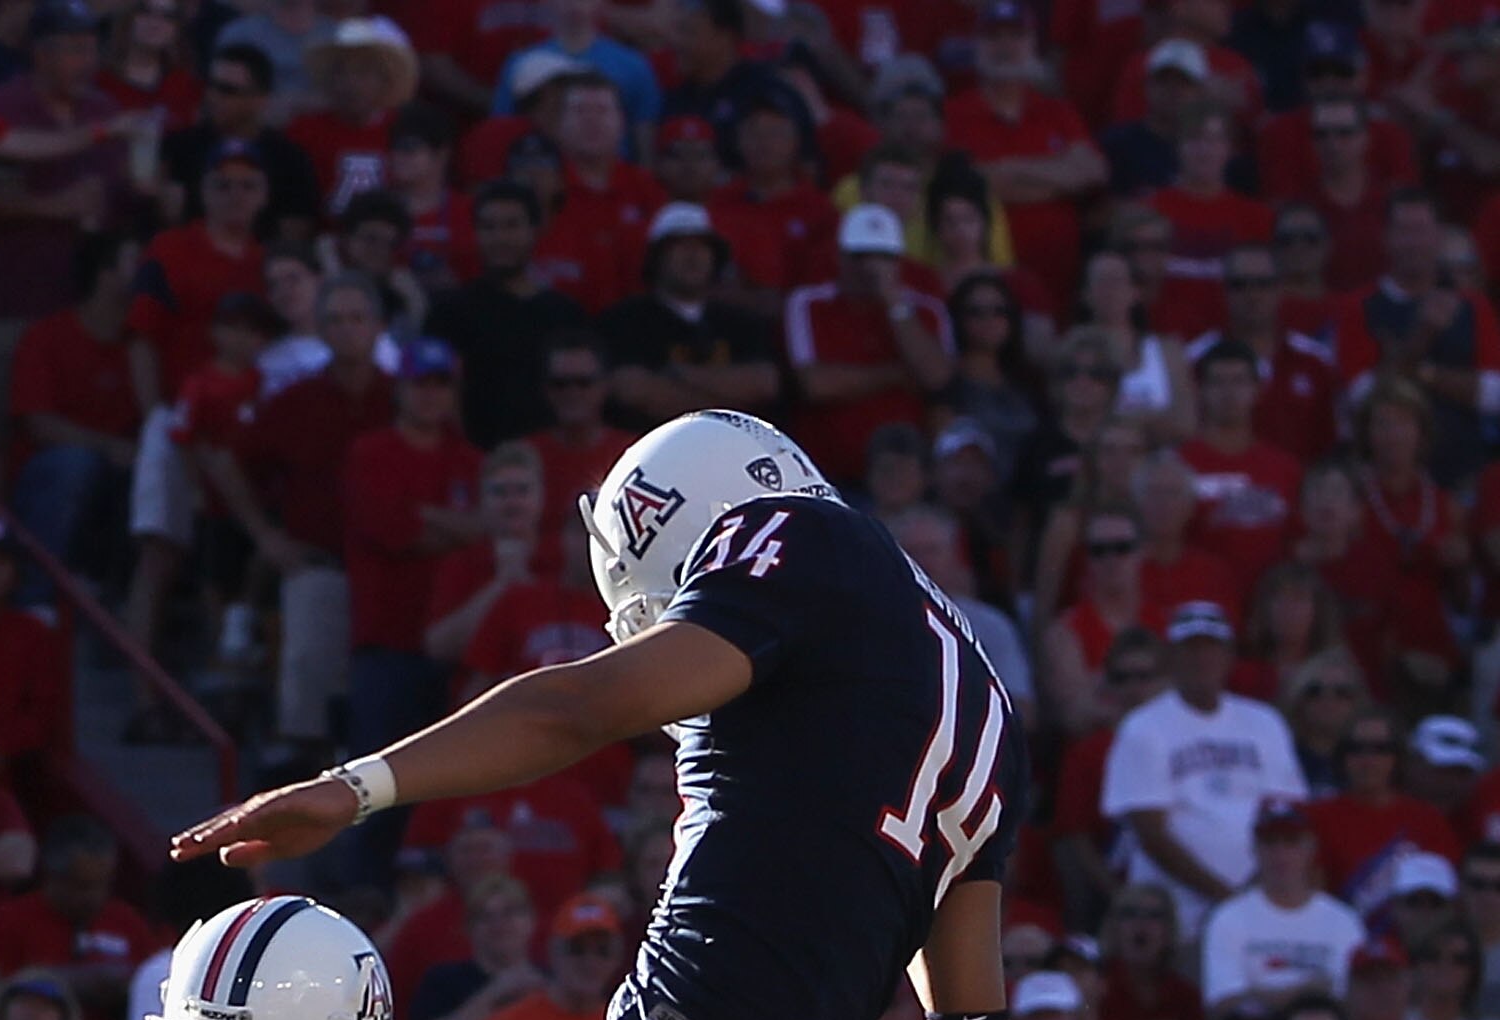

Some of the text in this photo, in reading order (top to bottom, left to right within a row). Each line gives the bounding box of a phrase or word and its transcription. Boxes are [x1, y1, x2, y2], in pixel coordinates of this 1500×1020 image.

[615, 466, 685, 560] A
[703, 509, 791, 578] 14
[879, 606, 1005, 911] 14
